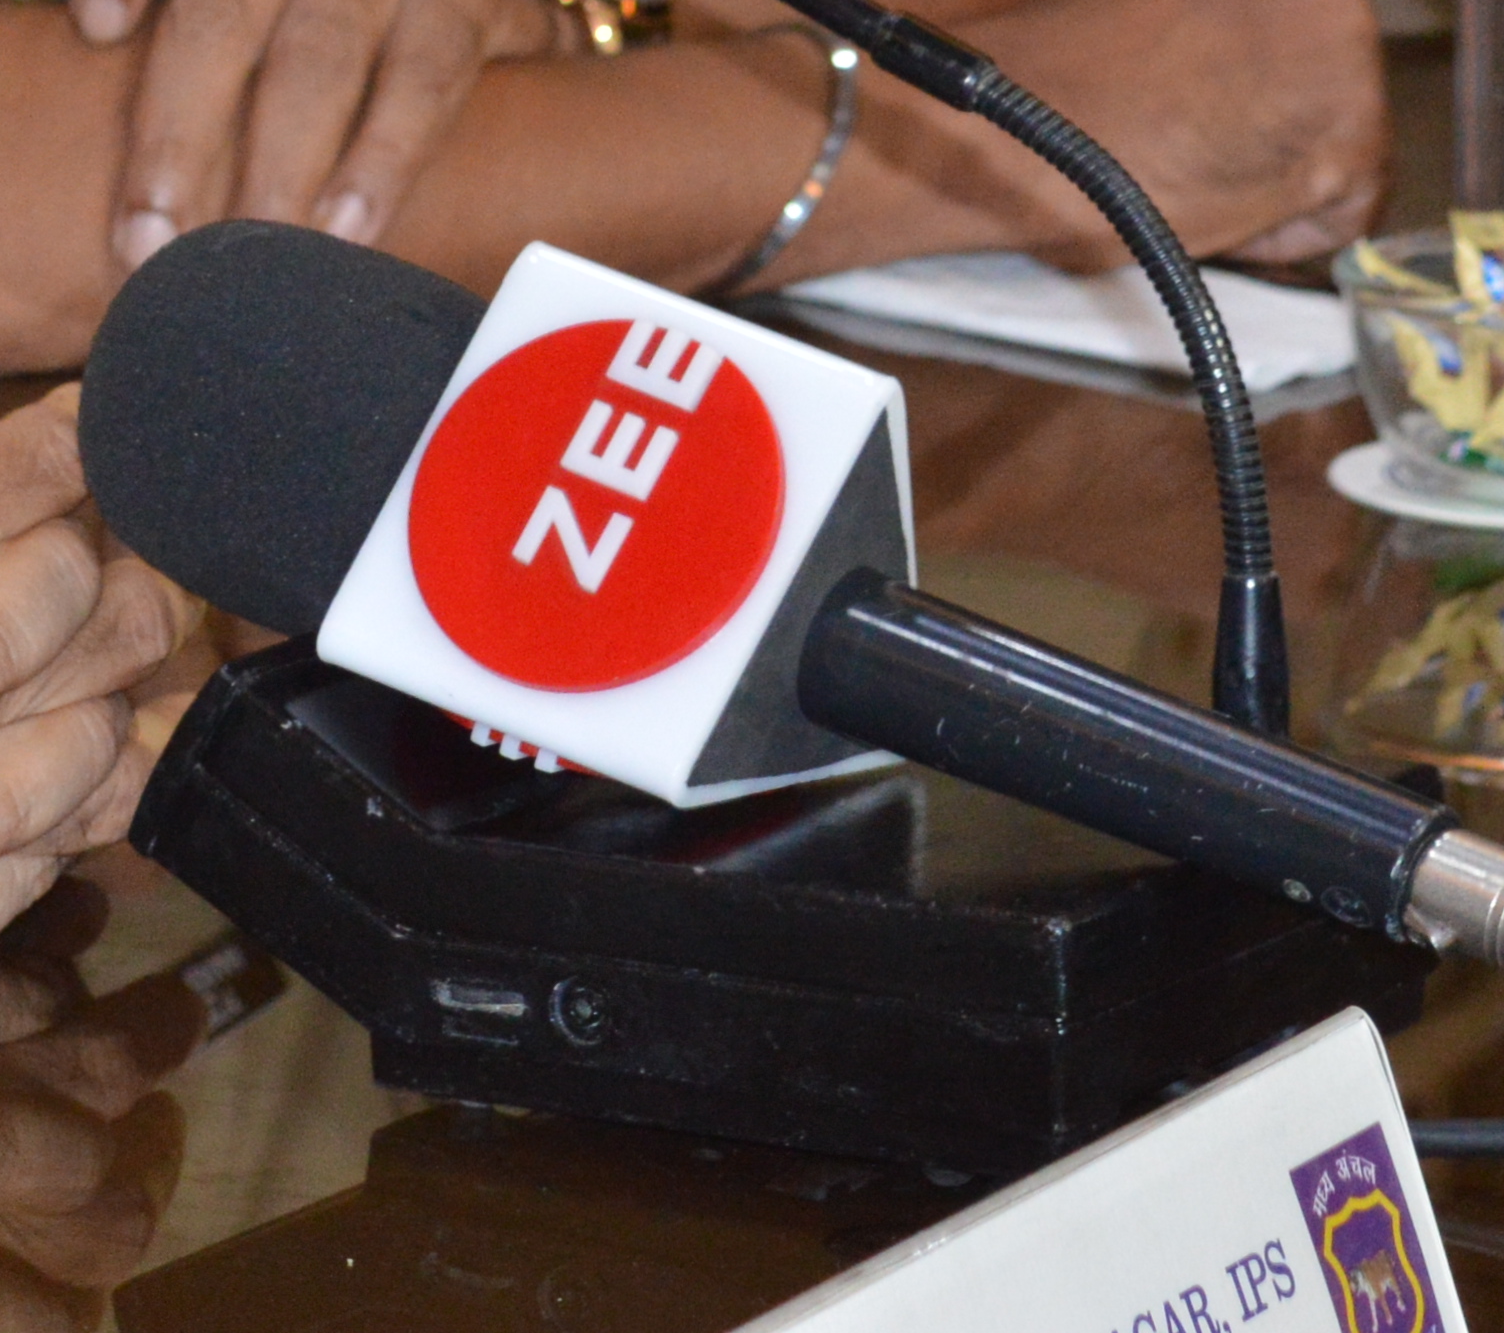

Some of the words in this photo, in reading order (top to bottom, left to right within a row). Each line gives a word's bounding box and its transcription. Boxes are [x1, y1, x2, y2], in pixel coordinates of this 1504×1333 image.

[510, 317, 725, 595] ZEE
[1312, 1169, 1336, 1219] मध्य
[1335, 1148, 1377, 1186] अंचल
[1225, 1237, 1296, 1323] IPS
